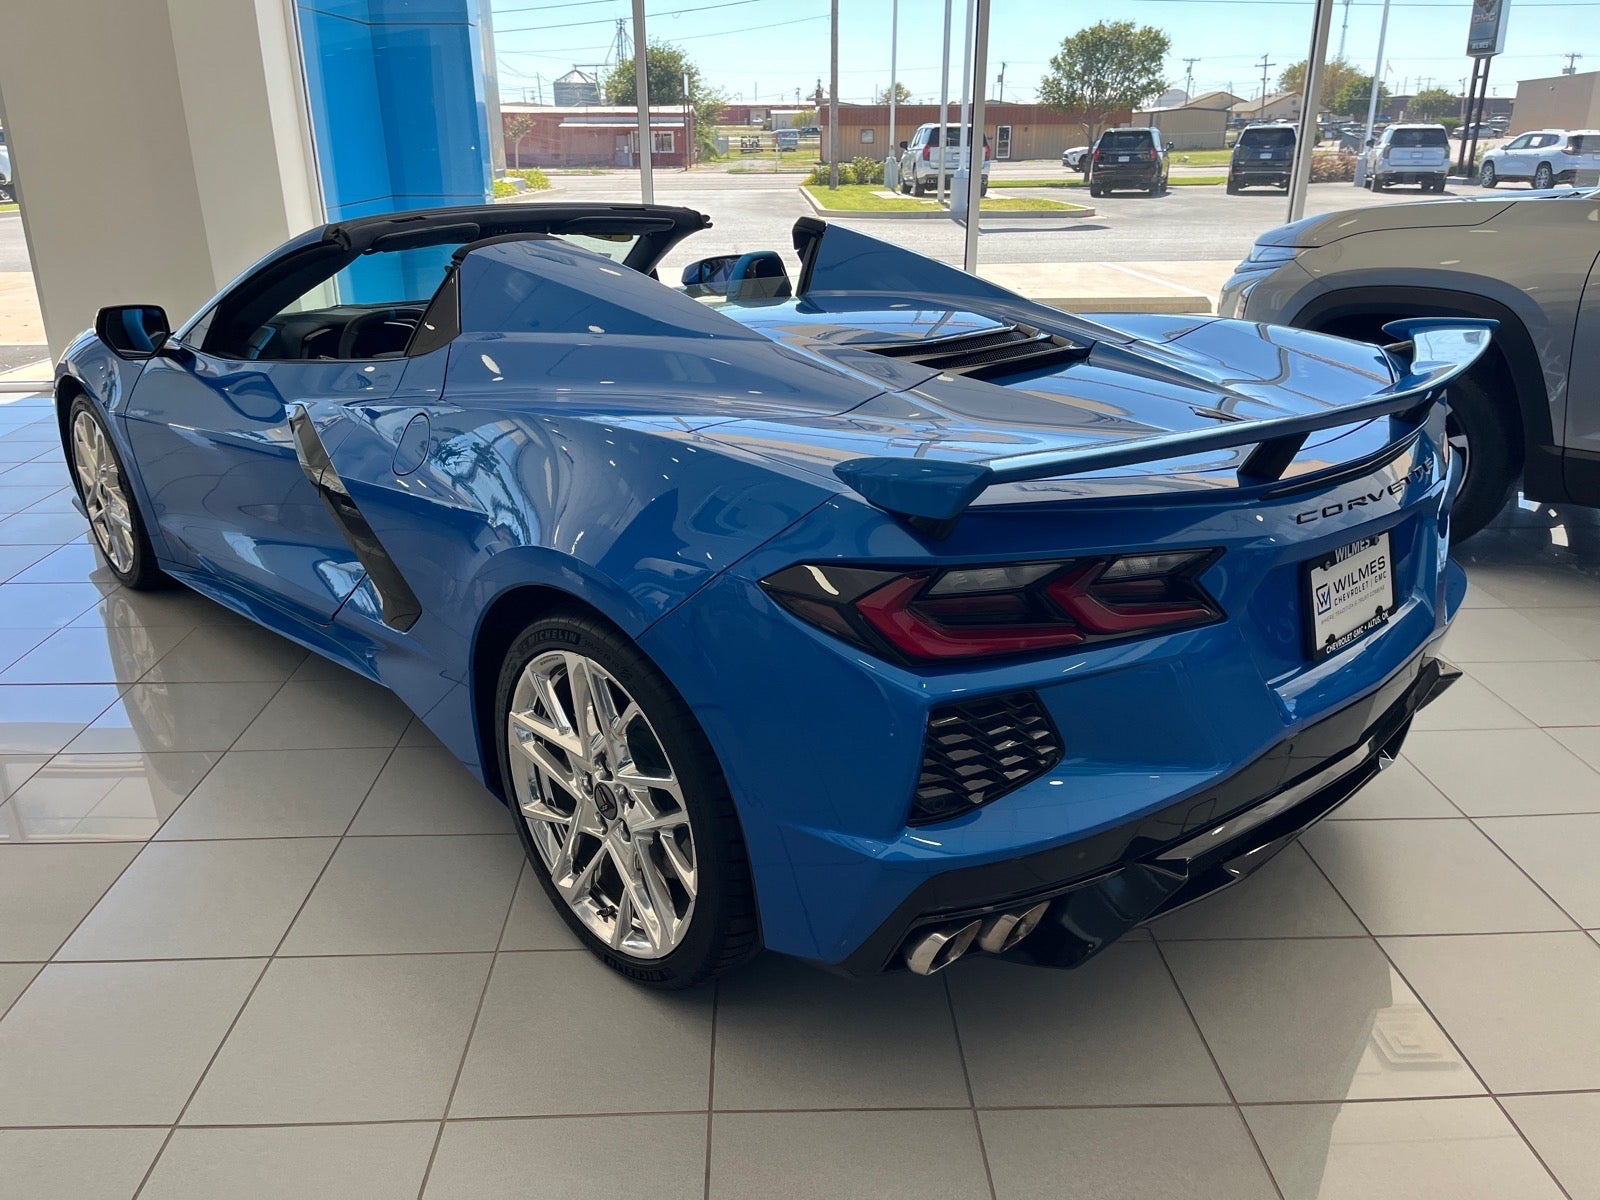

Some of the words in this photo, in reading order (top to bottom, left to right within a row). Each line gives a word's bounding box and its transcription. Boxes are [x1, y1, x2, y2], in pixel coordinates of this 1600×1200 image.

[1473, 12, 1496, 22] GMC
[1296, 456, 1434, 525] CORVETTE
[1335, 539, 1371, 564] WILMES
[1333, 555, 1386, 594] WILMES
[1334, 580, 1369, 606] CHEVROLET
[1374, 570, 1387, 584] GMC
[528, 629, 577, 645] MICHELIN
[1326, 632, 1353, 654] CHEVROLET
[1381, 611, 1389, 621] OK
